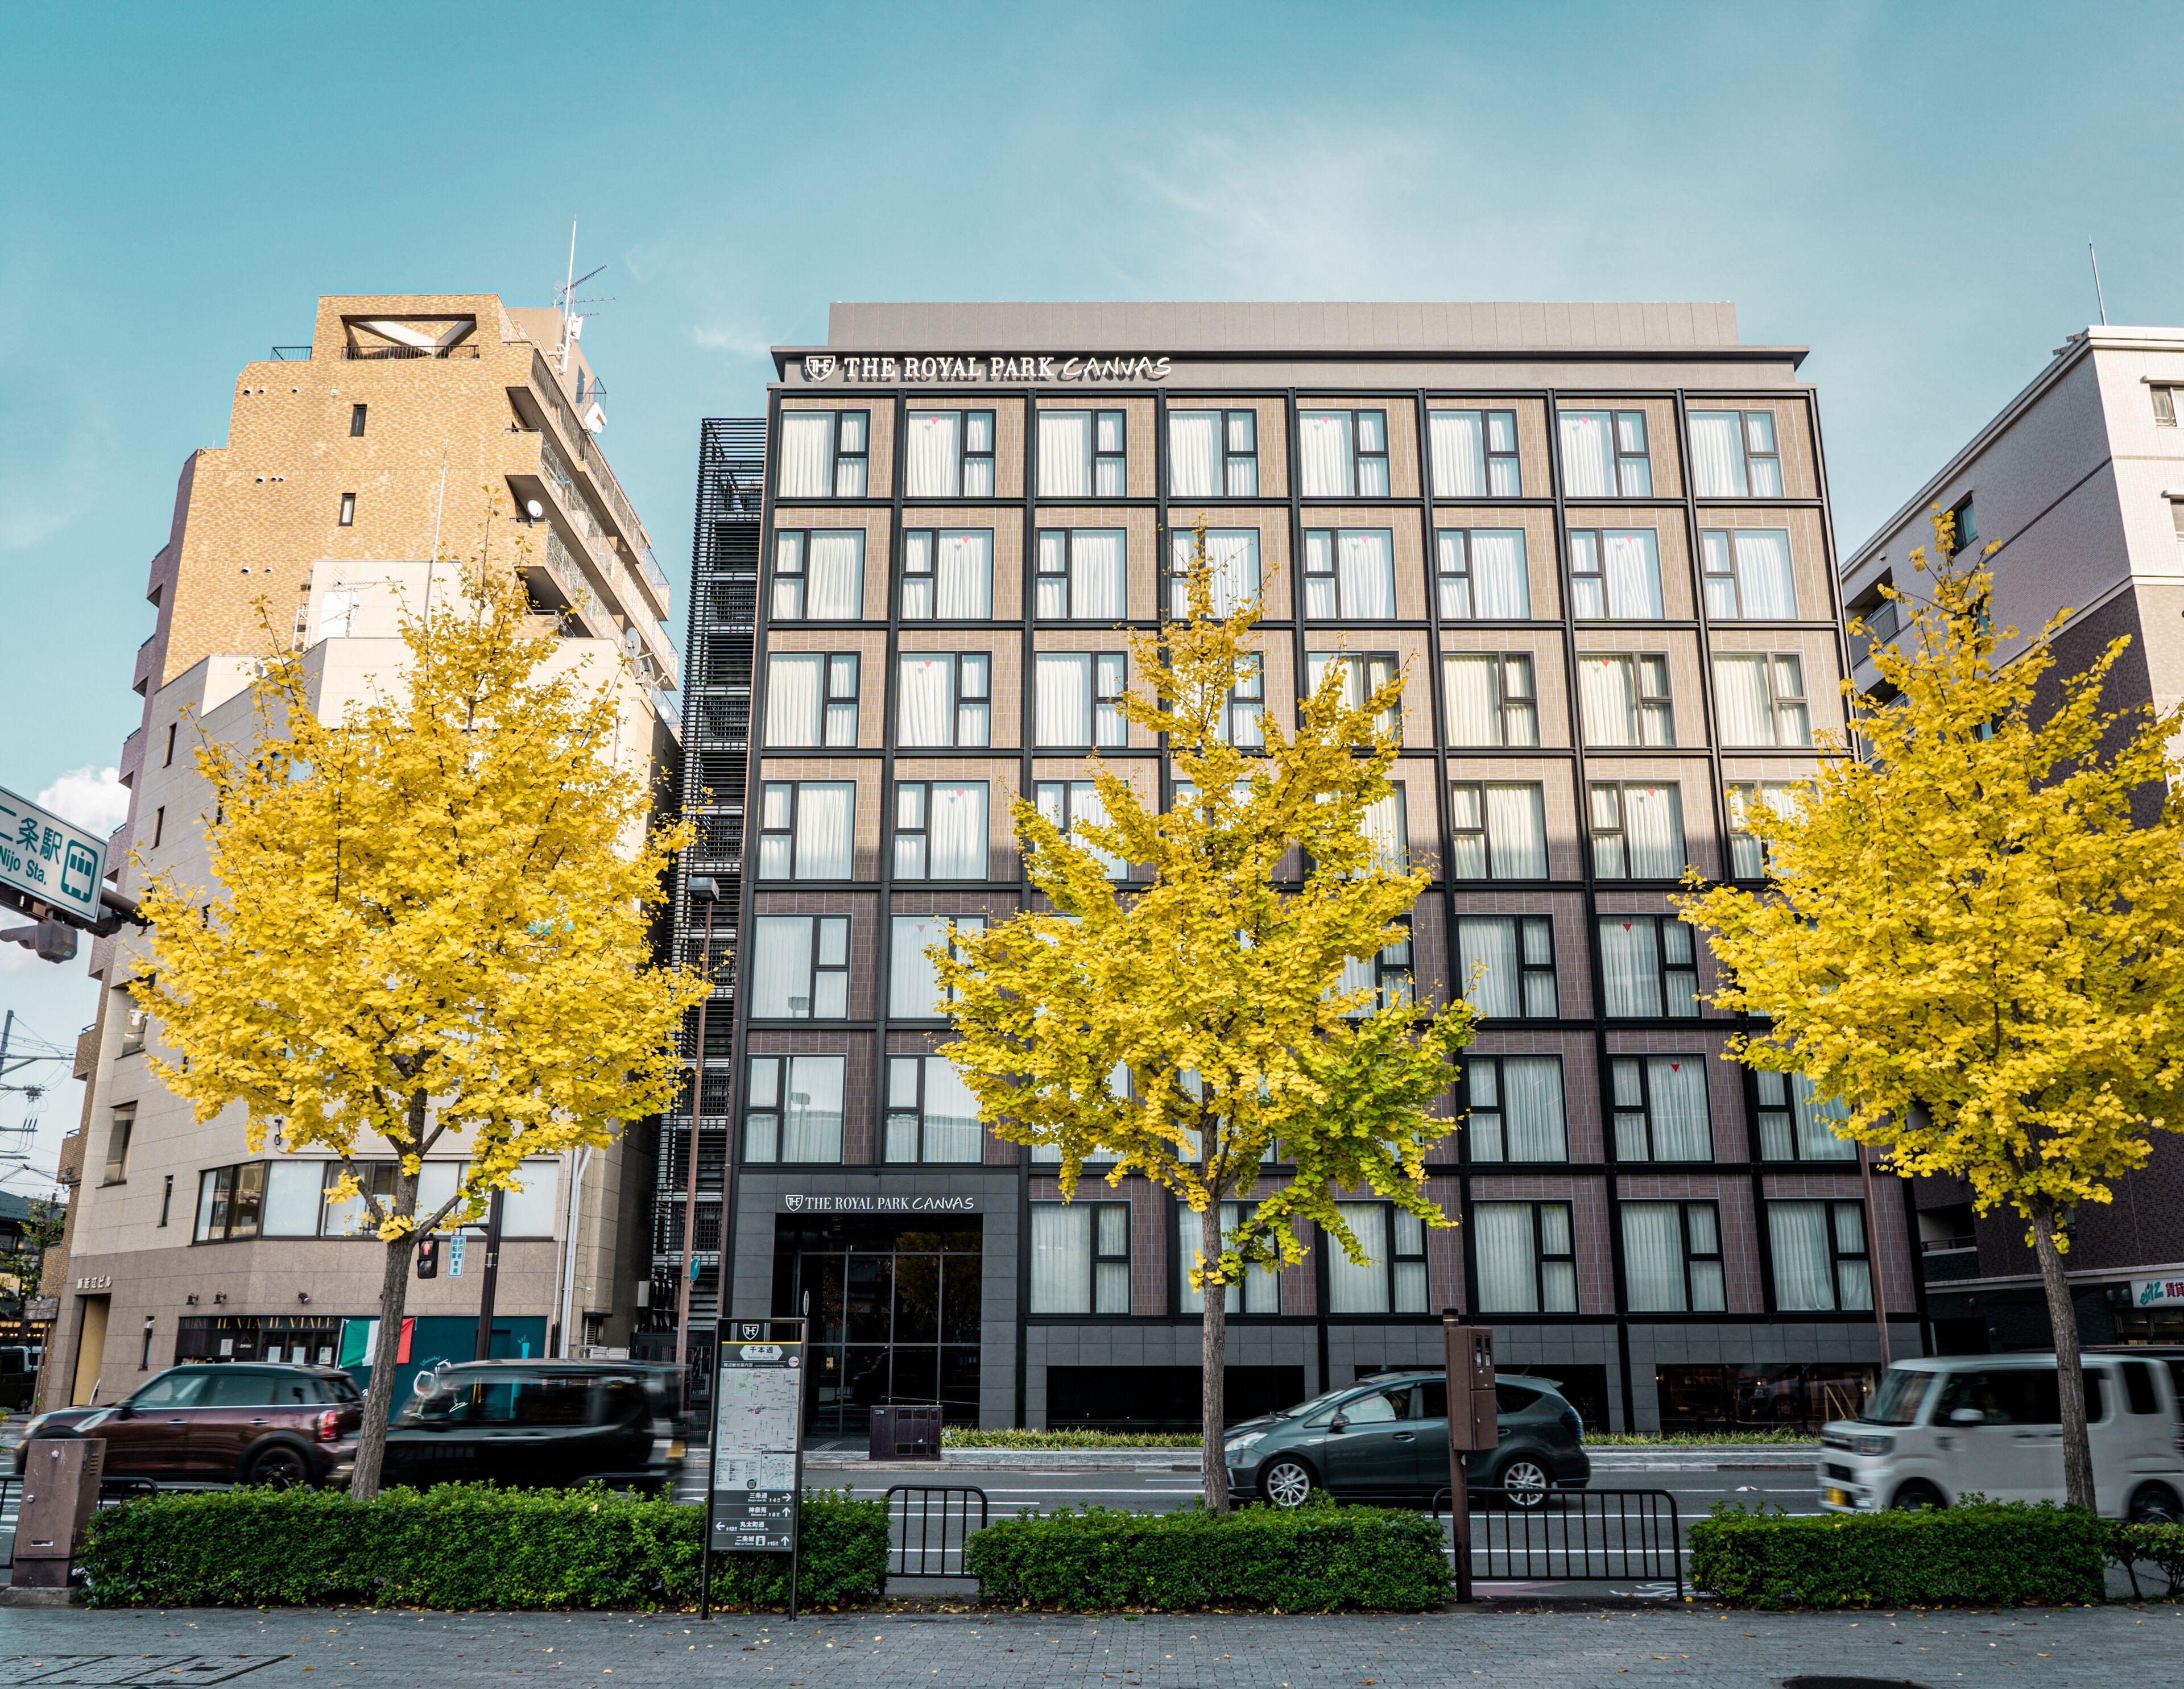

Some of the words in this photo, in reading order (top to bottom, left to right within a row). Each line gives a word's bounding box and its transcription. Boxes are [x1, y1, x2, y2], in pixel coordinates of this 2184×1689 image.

[844, 358, 895, 377] THE
[904, 357, 982, 377] ROYAL
[990, 357, 1054, 377] PARK
[1063, 357, 1172, 377] CANVAS
[0, 805, 63, 864] 二条駅
[0, 845, 20, 872] Nijo
[26, 859, 47, 885] Sta.
[805, 1197, 832, 1210] THE
[835, 1197, 874, 1210] ROYAL
[878, 1197, 909, 1210] PARK
[912, 1197, 974, 1210] CANVAS
[2165, 1282, 2184, 1298] 賃貸
[216, 1318, 230, 1329] IL
[269, 1317, 283, 1328] IL
[289, 1317, 335, 1328] VIALE
